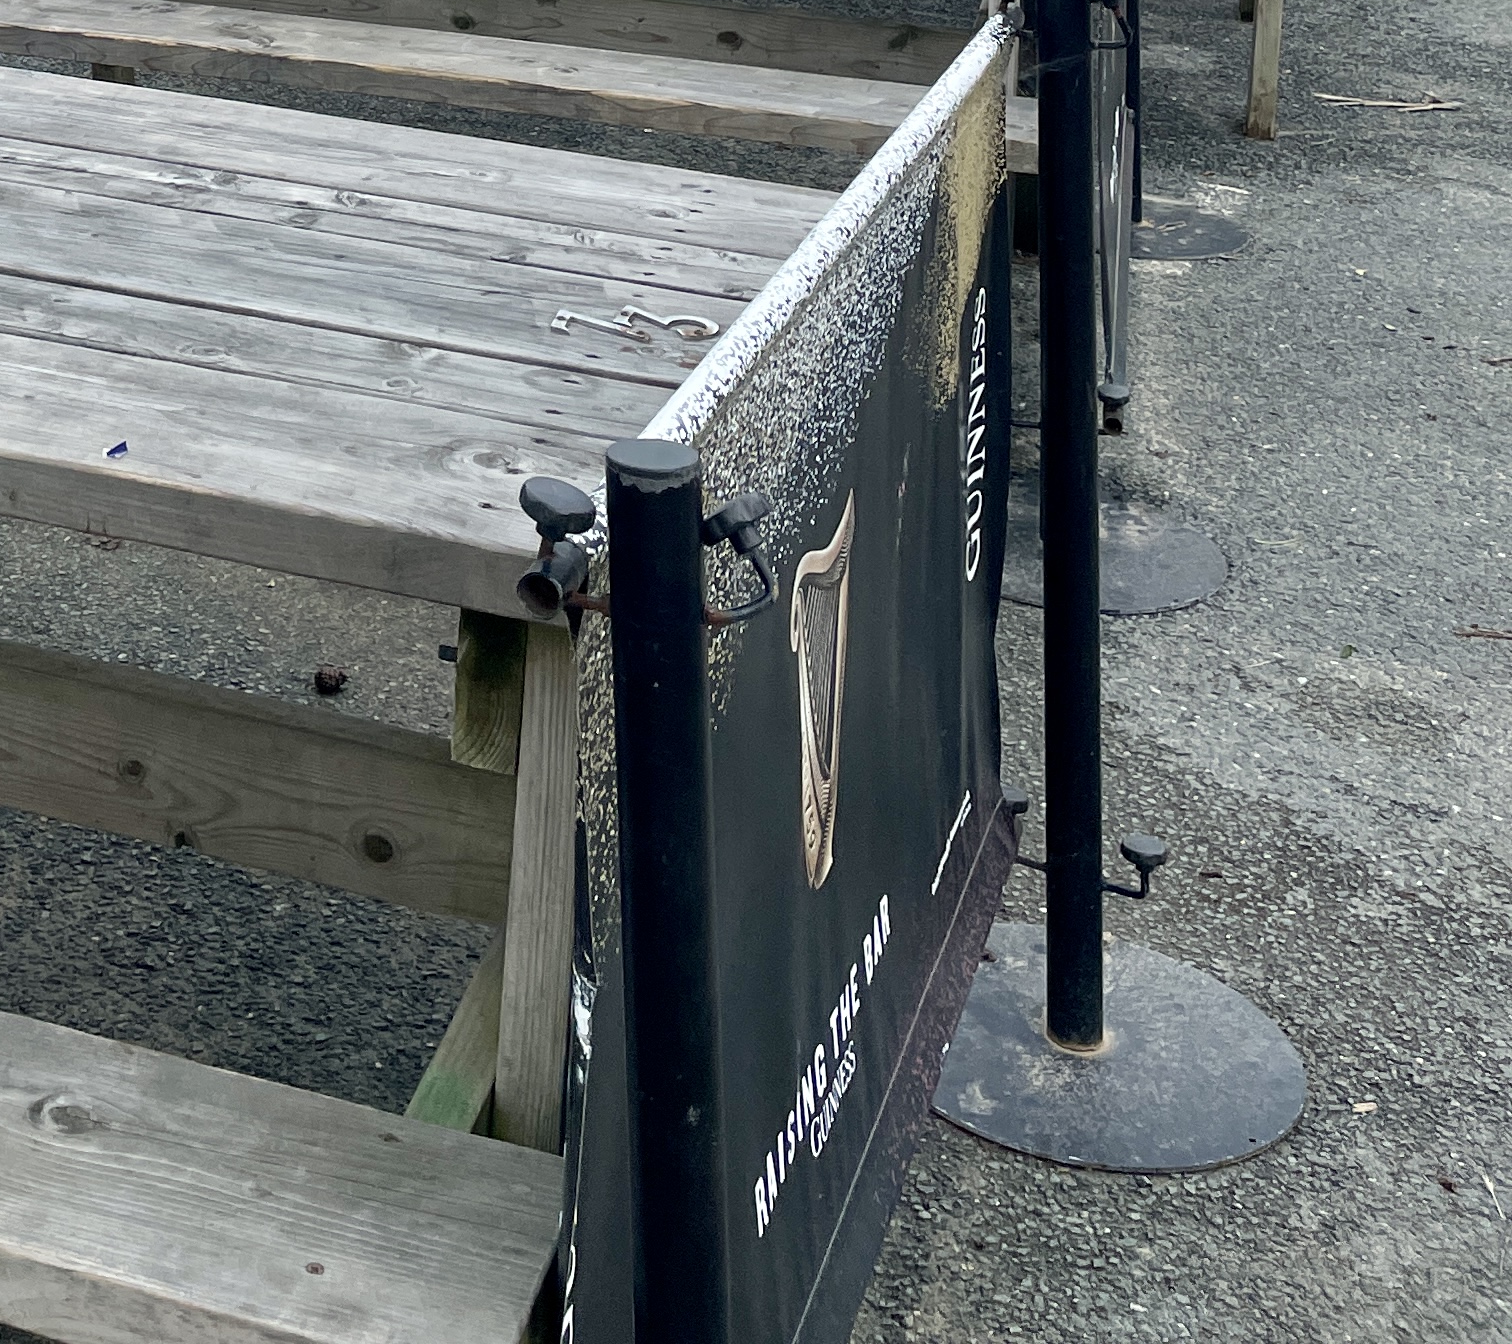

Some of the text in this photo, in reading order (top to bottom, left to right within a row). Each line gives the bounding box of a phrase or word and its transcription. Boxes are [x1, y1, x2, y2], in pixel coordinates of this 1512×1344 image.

[964, 286, 987, 582] GUINNESS
[753, 893, 891, 1238] RAISING THE BAR
[809, 1039, 857, 1159] GUINNESS
